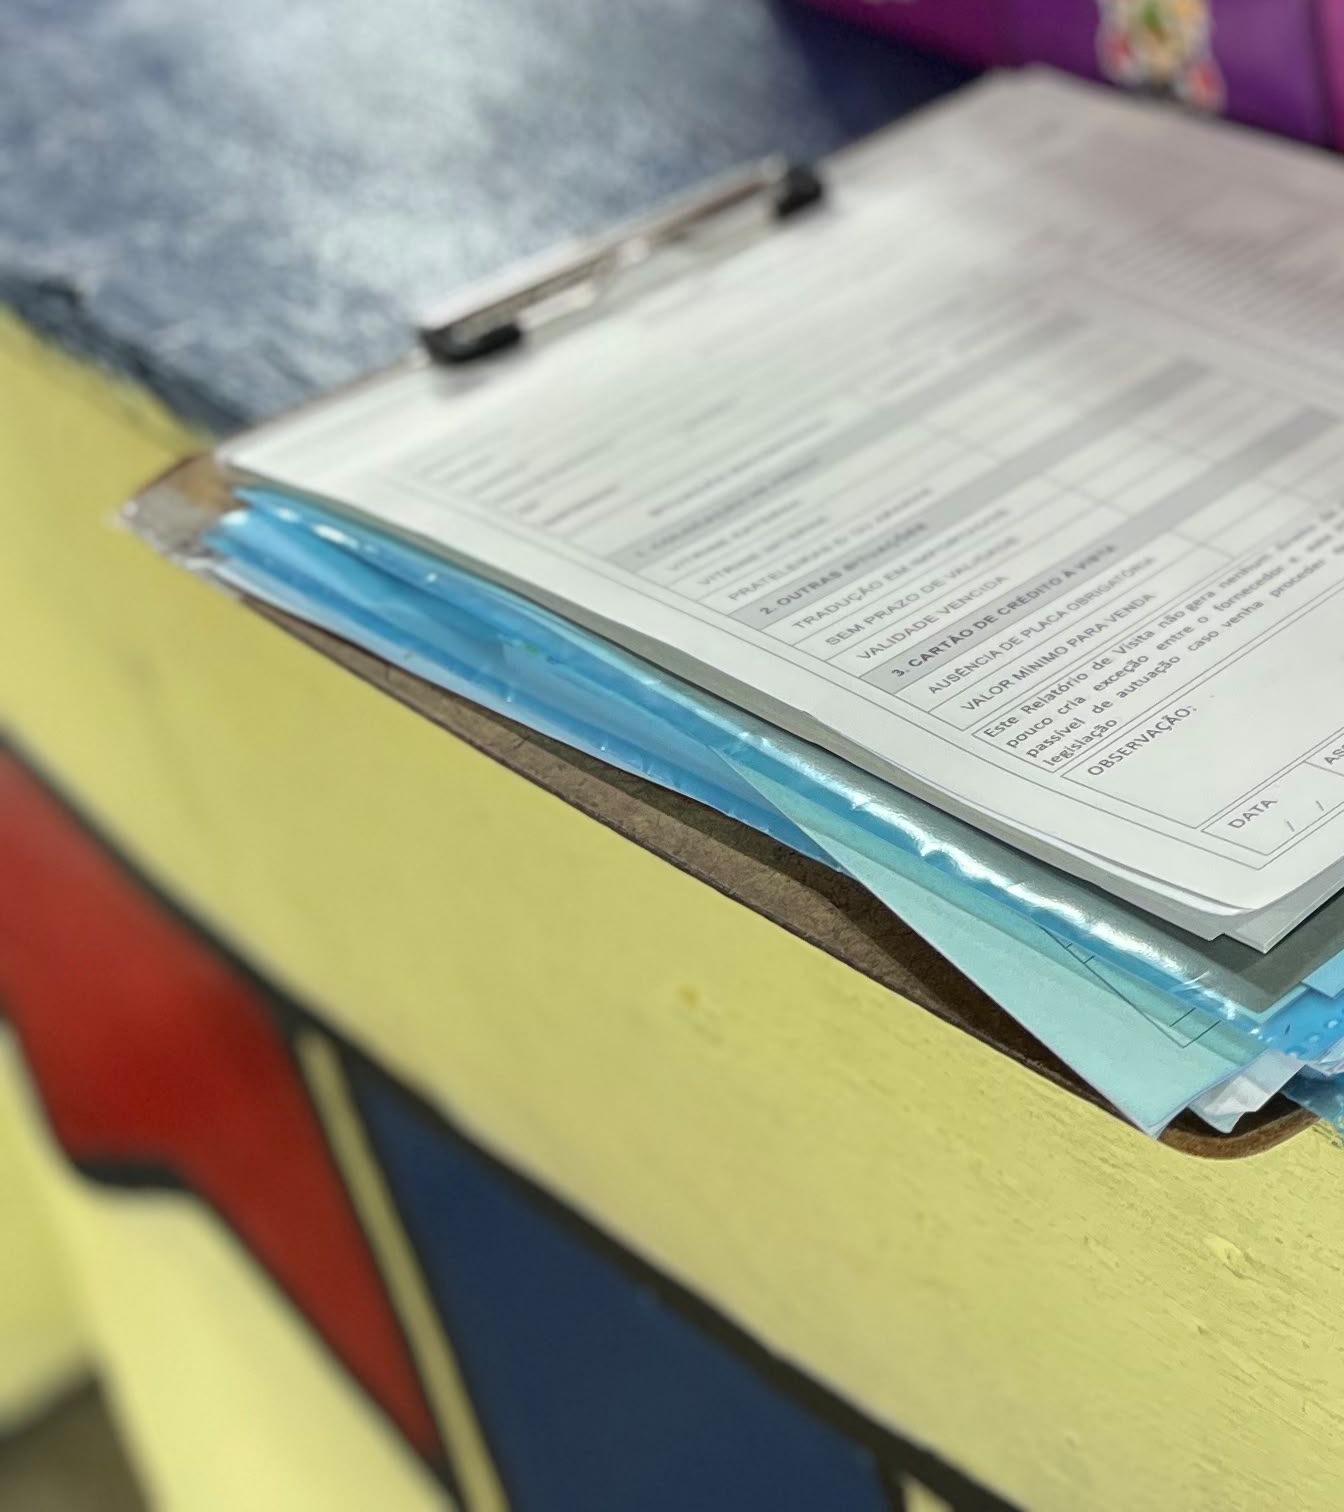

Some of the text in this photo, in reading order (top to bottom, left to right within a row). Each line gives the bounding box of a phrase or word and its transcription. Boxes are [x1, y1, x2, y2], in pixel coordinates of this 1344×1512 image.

[855, 575, 1009, 659] VALIDADE VENCIDA
[890, 576, 1063, 677] 3. CARTÃO DE CRÉDITO
[927, 649, 1004, 695] AUSÊNCIA
[998, 635, 1024, 652] DE
[1019, 609, 1069, 639] PLACA
[960, 593, 1155, 710] VALOR MÍNIMO PARA VENDA
[975, 706, 1020, 738] Este
[1012, 663, 1089, 715] Relatório
[1081, 648, 1113, 671] de
[1104, 621, 1156, 654] Visita
[1147, 605, 1186, 629] não
[1184, 590, 1217, 612] gera
[1005, 716, 1054, 749] pouco
[1056, 695, 1087, 715] cria
[1092, 654, 1150, 692] exceção
[1155, 625, 1195, 651] entre
[1196, 615, 1210, 624] o
[1025, 716, 1086, 759] passível
[1091, 699, 1114, 714] de
[1115, 655, 1181, 699] autuação
[1186, 629, 1220, 651] caso
[1220, 600, 1265, 628] venha
[1041, 718, 1126, 766] legislação
[1086, 704, 1197, 776] OBSERVAÇÃO:
[1226, 799, 1278, 829] DATA
